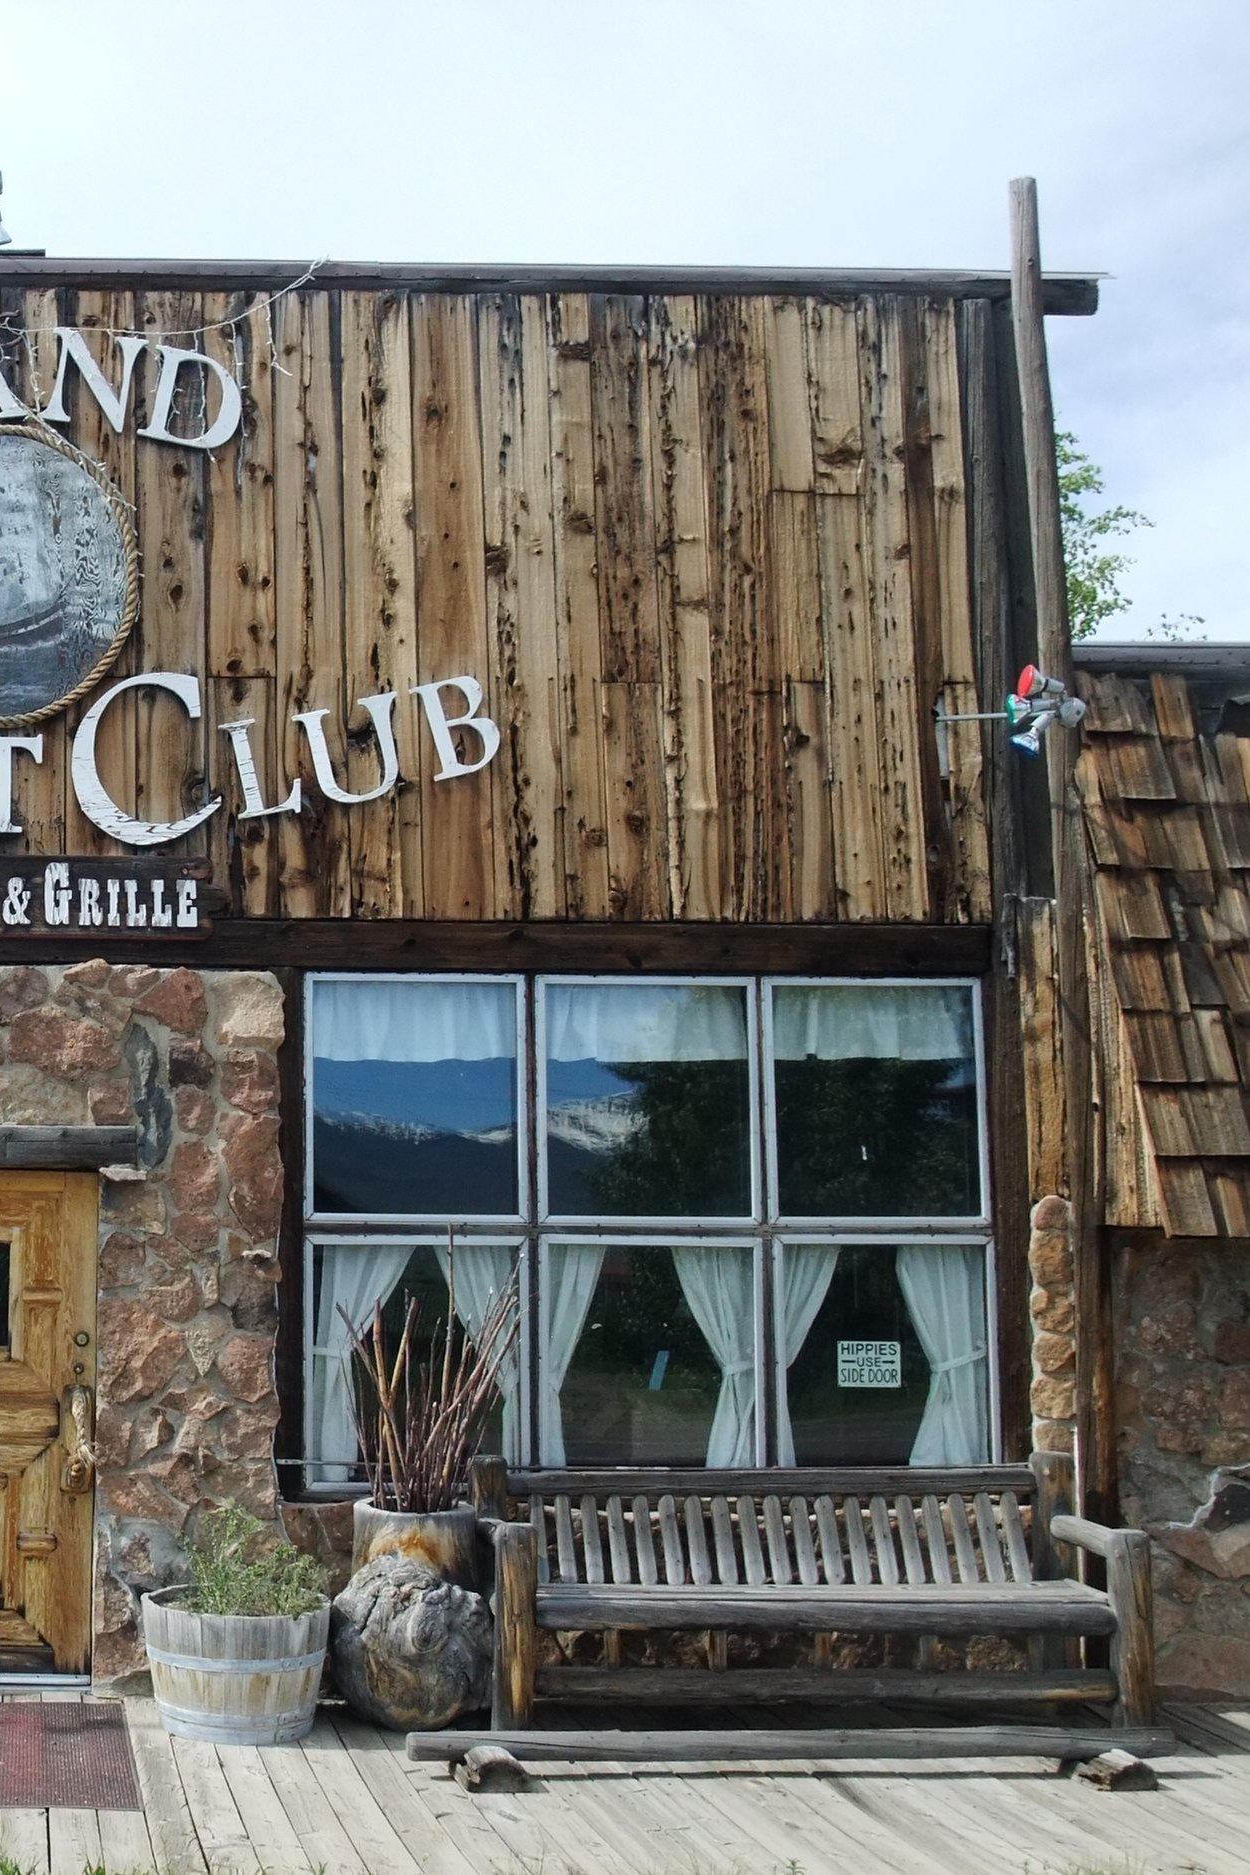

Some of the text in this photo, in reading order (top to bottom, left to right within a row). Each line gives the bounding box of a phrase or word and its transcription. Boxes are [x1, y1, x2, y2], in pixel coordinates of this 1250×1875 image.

[71, 671, 501, 846] CLUB
[2, 876, 31, 926] &
[43, 861, 199, 928] GRILLE
[840, 1343, 897, 1356] HIPPIES
[856, 1357, 881, 1368] USE
[840, 1368, 898, 1384] SIDE DOOR
